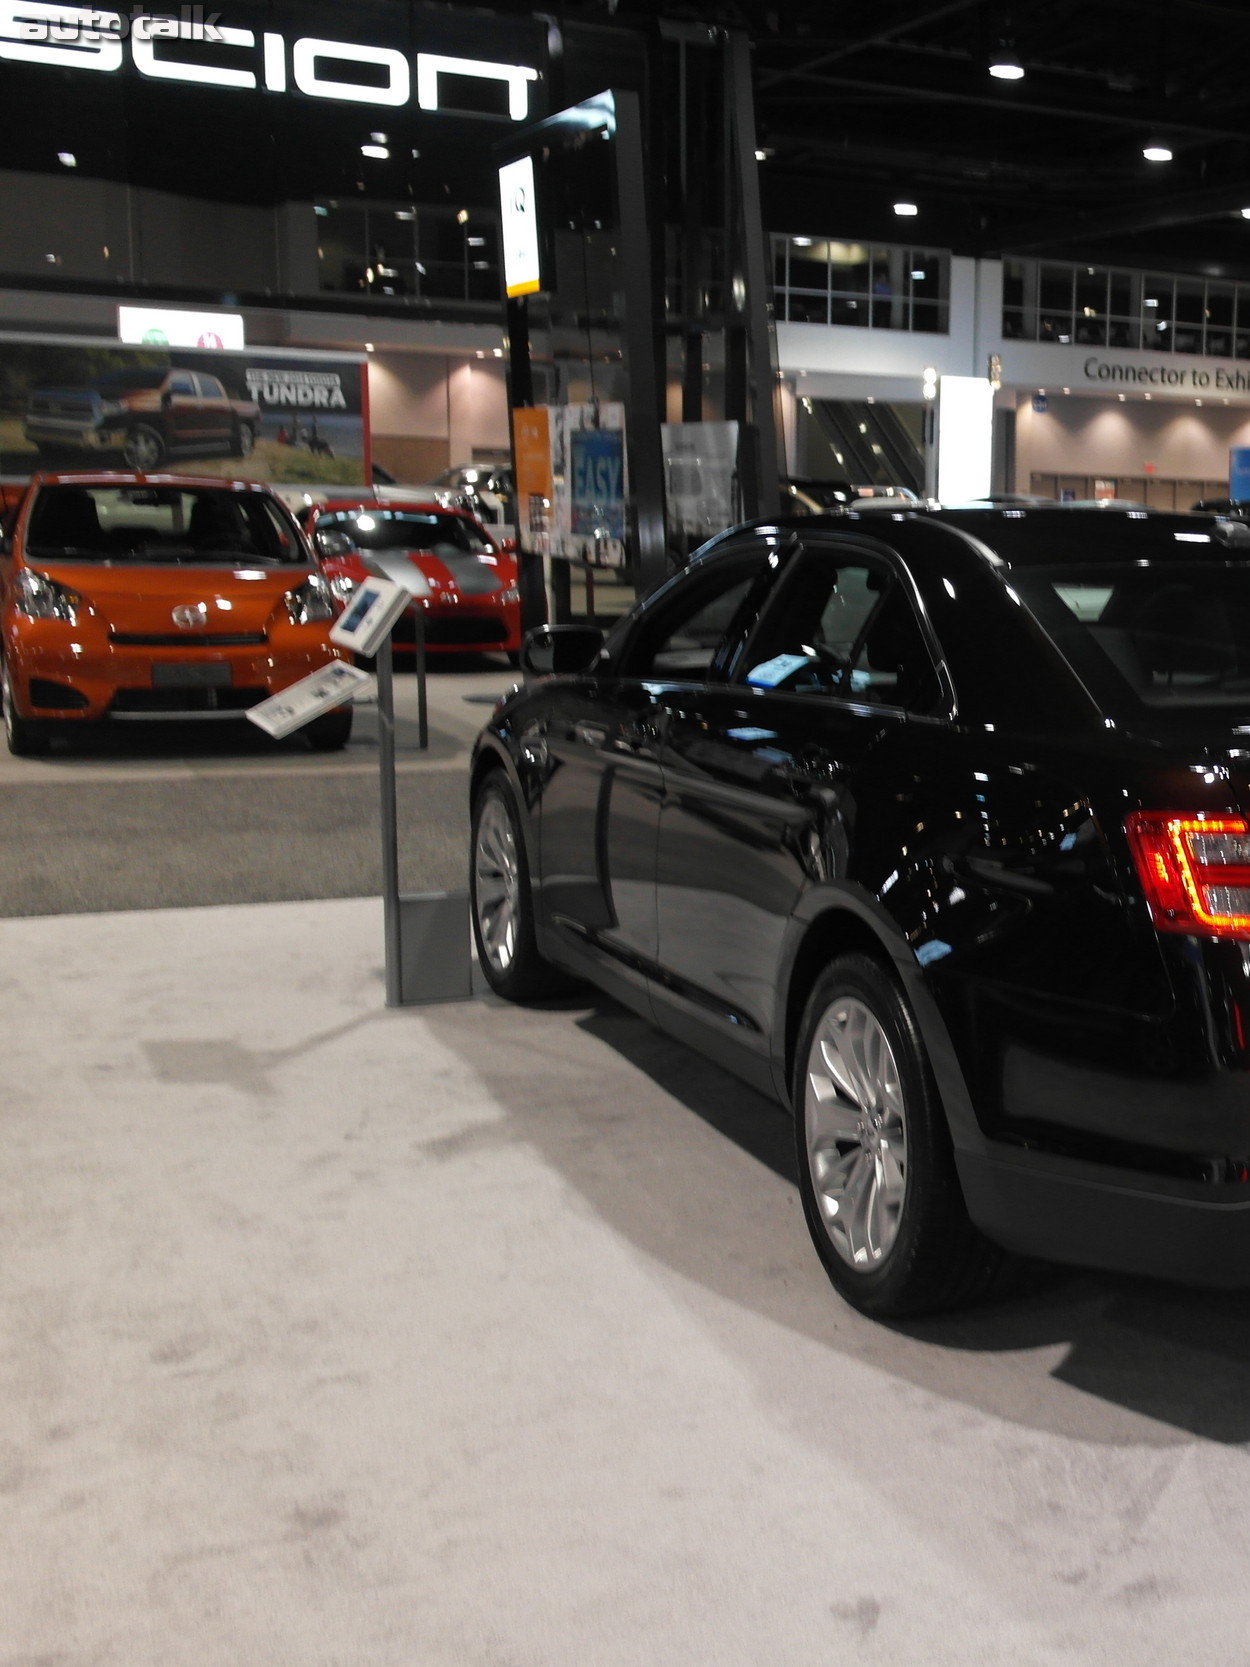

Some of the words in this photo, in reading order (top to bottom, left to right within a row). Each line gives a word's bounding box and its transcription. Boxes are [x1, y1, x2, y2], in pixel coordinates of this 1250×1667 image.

[1083, 357, 1186, 386] Connector
[1191, 367, 1210, 386] to
[246, 380, 347, 409] TUNDRA
